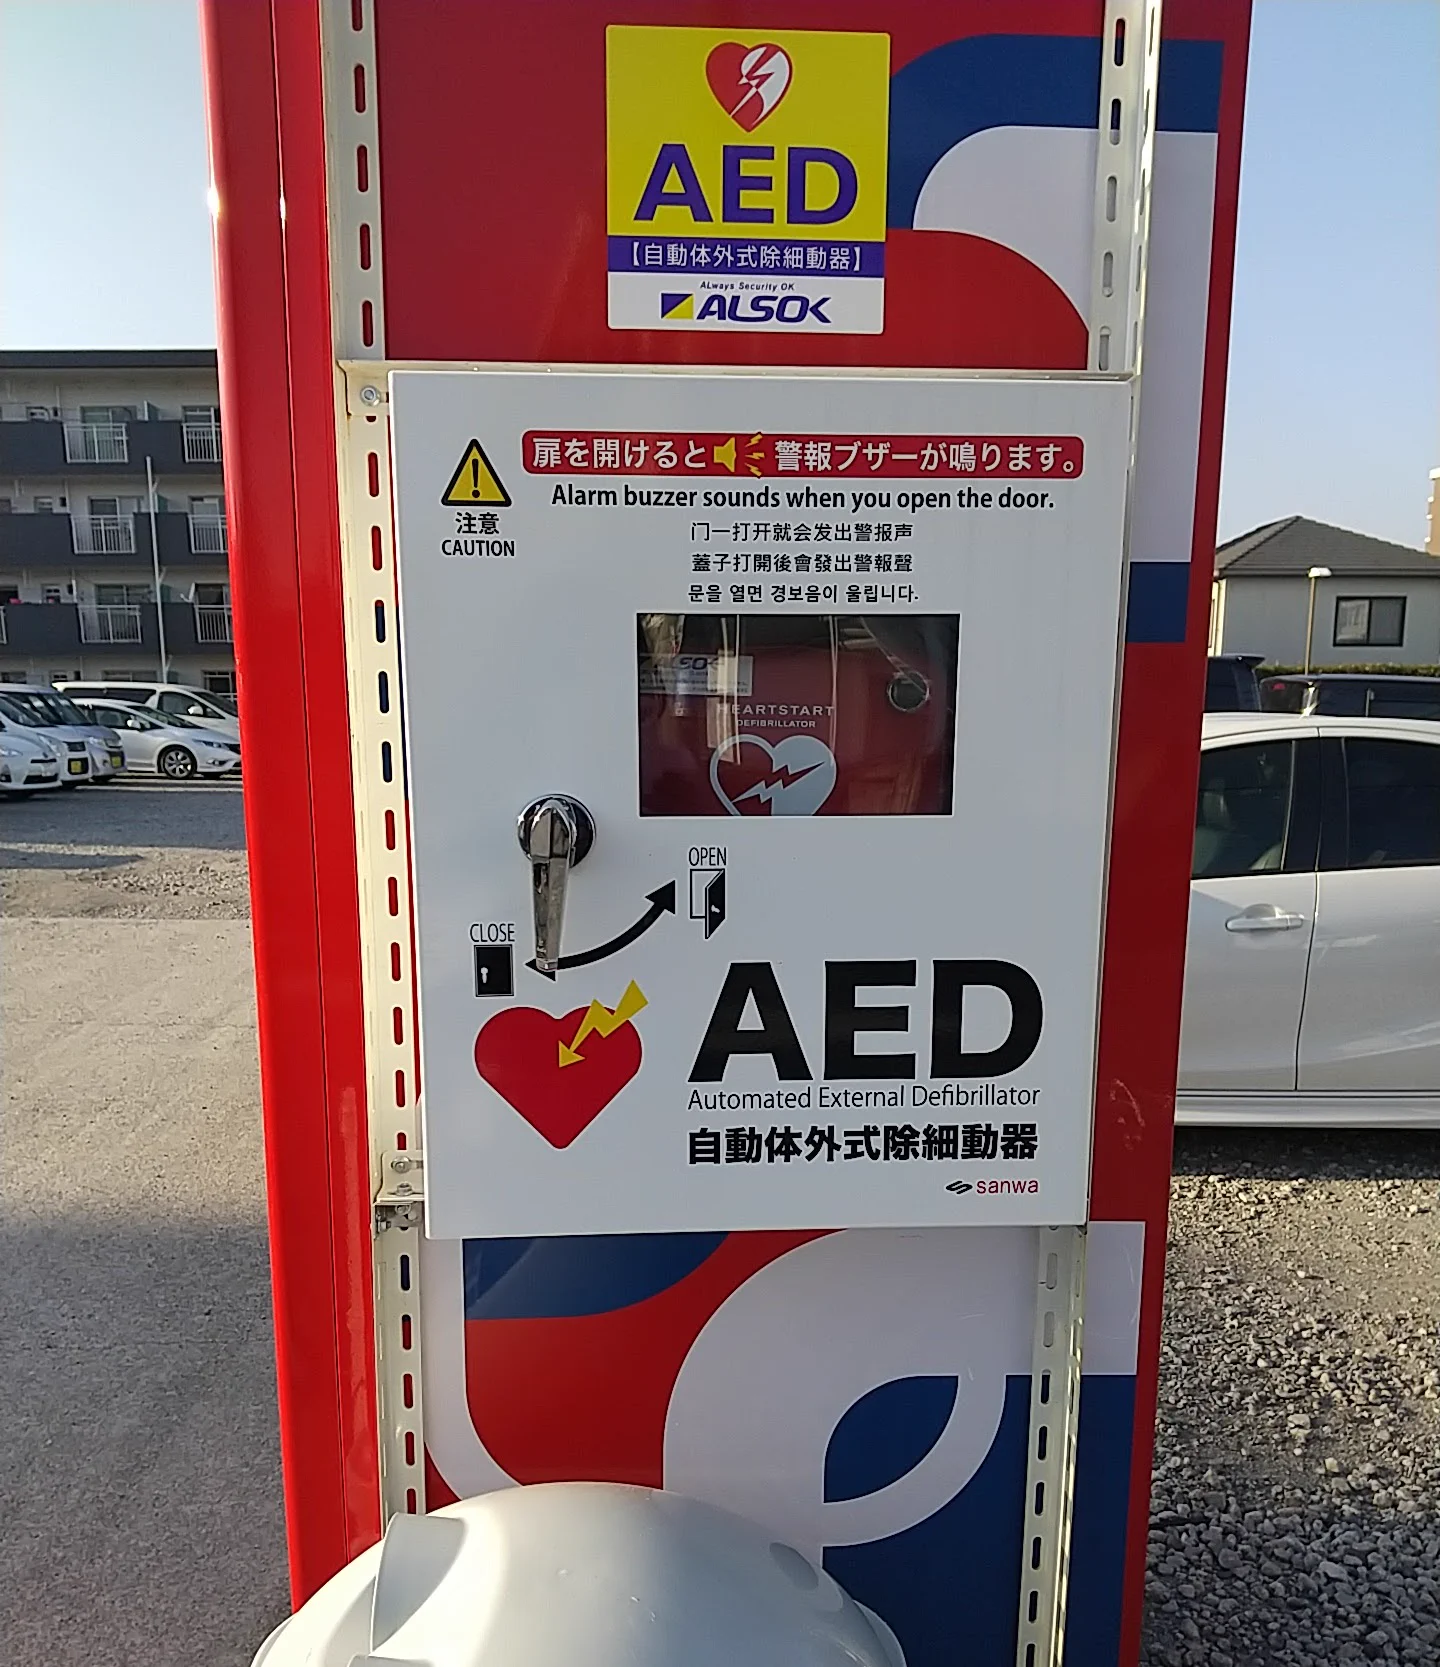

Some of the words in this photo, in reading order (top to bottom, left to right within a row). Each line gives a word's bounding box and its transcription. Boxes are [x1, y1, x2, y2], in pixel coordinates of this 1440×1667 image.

[633, 143, 858, 225] AED
[633, 241, 861, 272] 【自動体外式除細動器】
[738, 281, 778, 292] Security
[780, 282, 795, 291] OK
[696, 294, 832, 324] ALSOK
[532, 437, 707, 469] 扉を開けると
[774, 440, 1076, 473] 警報ブザーが鳴ります。
[551, 484, 617, 506] Alarm
[623, 484, 698, 507] buzzer
[702, 486, 780, 508] sounds
[786, 486, 845, 508] when
[851, 490, 891, 513] you
[896, 490, 951, 513] open
[956, 487, 993, 508] the
[997, 487, 1055, 509] door.
[454, 512, 500, 535] 注意
[690, 521, 914, 543] 门一打开就会发出警报声
[441, 539, 516, 557] CAUTION
[691, 553, 914, 573] 蓋子打開後會發出警報聲
[688, 584, 723, 603] 문을
[728, 584, 763, 603] 열면
[770, 584, 838, 603] 경보음이
[845, 584, 919, 603] 울립니다.
[737, 719, 816, 728] DEFIBRILLATOR
[688, 847, 727, 866] OPEN
[469, 923, 516, 943] CLOSE
[687, 959, 1044, 1083] AED
[687, 1087, 811, 1111] Automated
[818, 1084, 905, 1109] External
[912, 1083, 1041, 1107] Defibrillator
[688, 1123, 1039, 1165] 自動体外式除細動器
[975, 1178, 1040, 1194] sanwa
